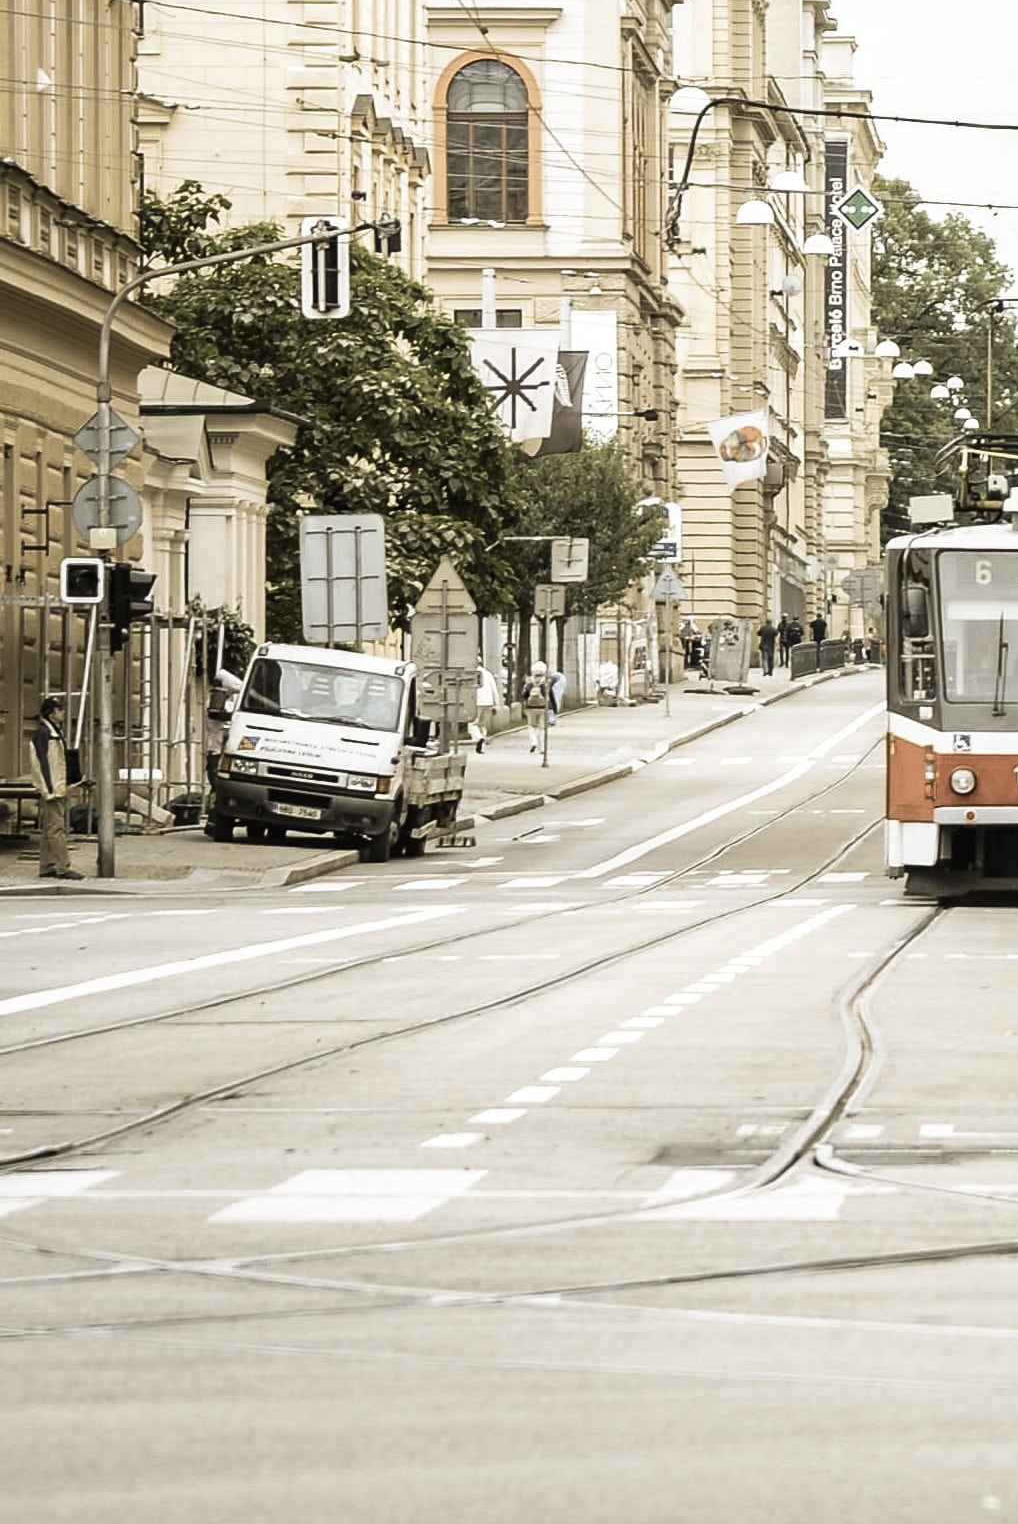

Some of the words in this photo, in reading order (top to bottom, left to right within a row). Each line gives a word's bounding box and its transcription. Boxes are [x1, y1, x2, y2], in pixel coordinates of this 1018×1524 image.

[828, 219, 843, 267] Palace
[828, 270, 843, 306] Brno
[975, 560, 993, 585] 6
